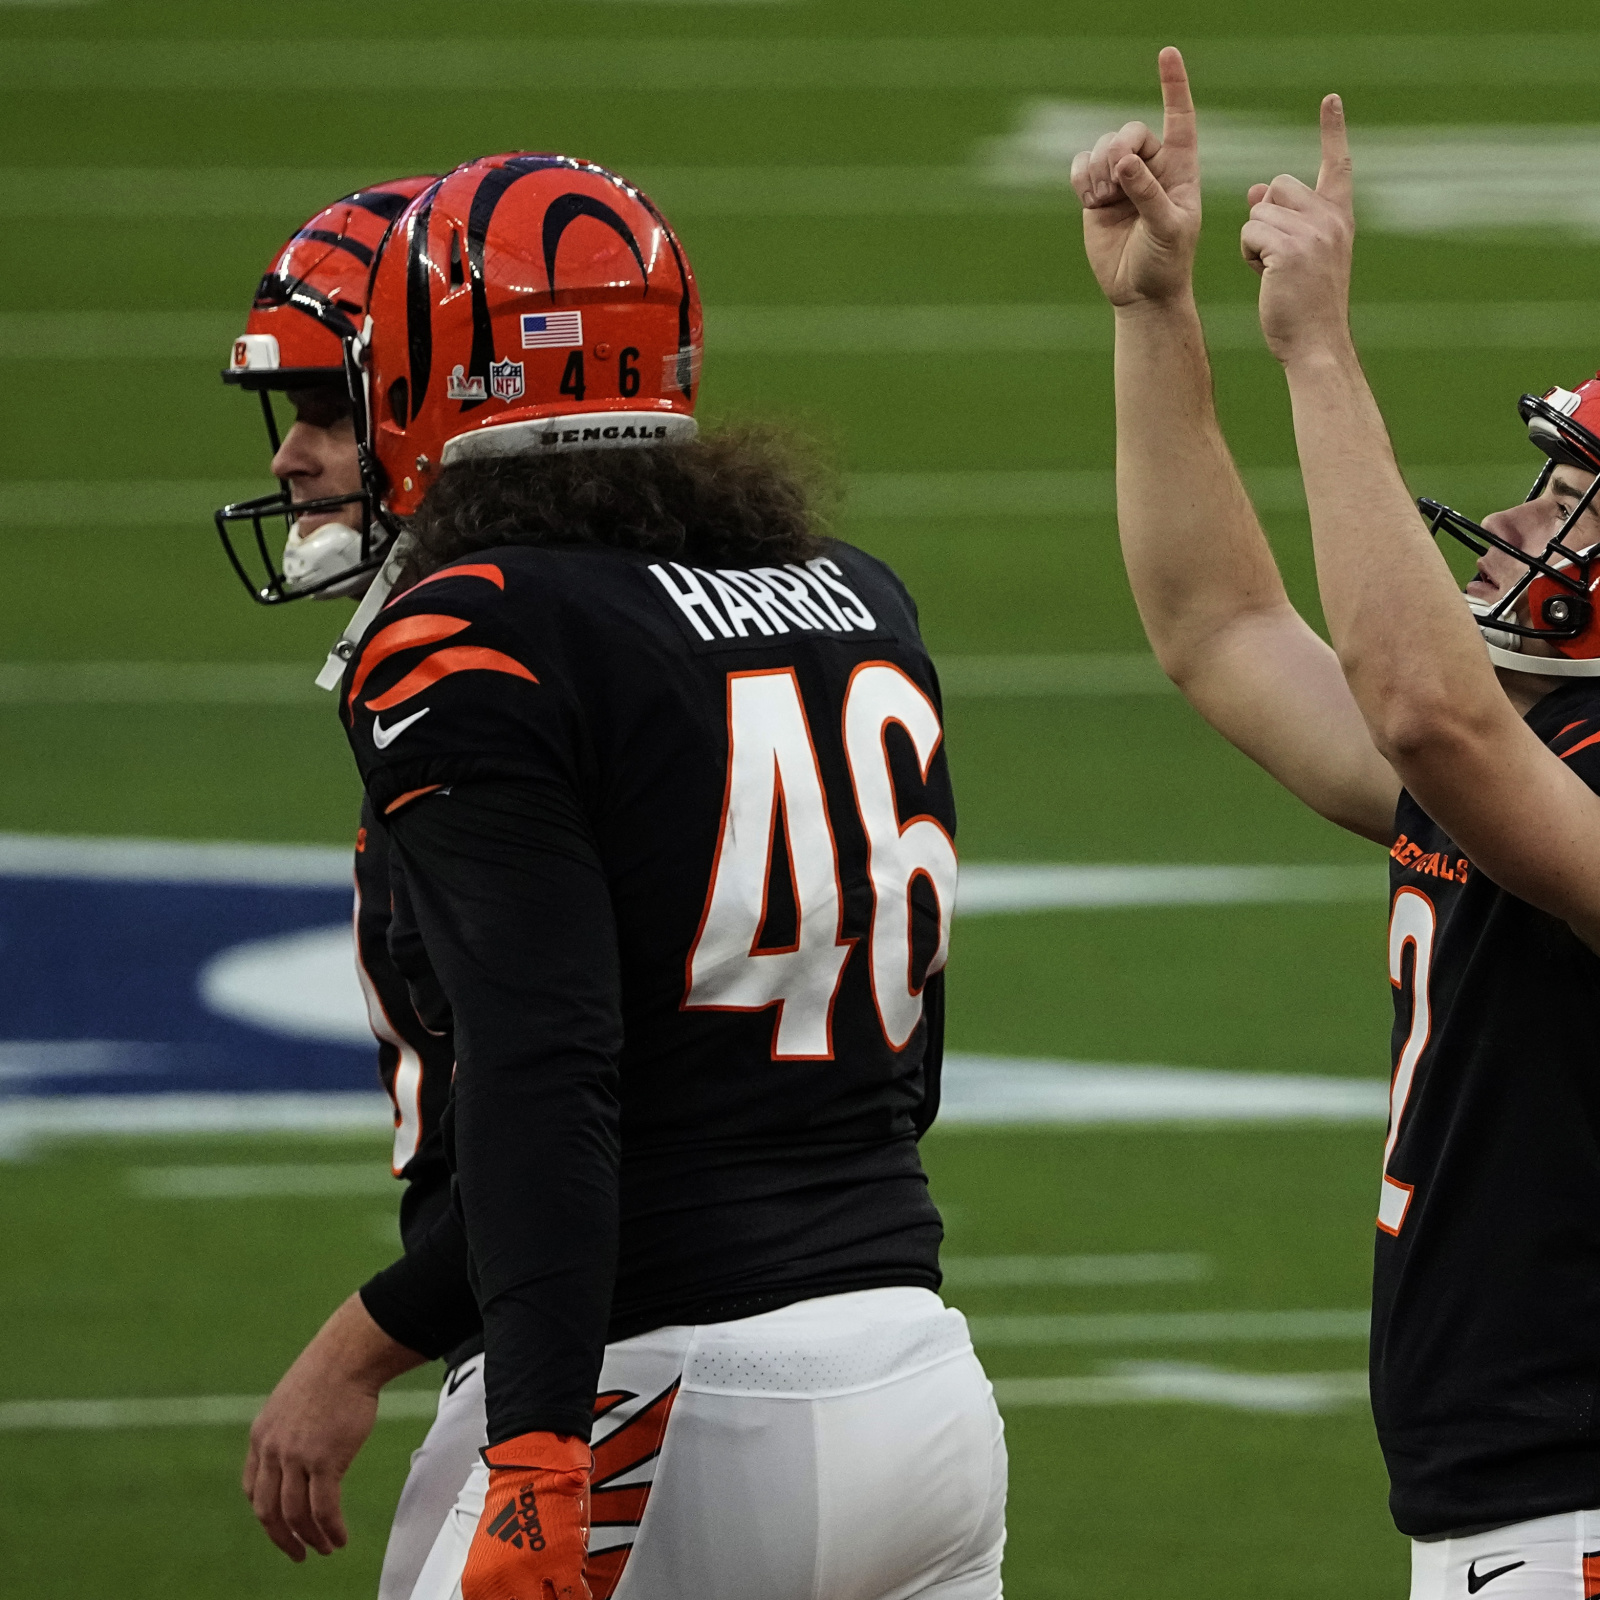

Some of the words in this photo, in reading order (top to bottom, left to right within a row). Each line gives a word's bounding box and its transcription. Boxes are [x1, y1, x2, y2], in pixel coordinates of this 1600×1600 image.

[496, 377, 520, 396] NFL
[541, 425, 667, 446] BENGALS
[647, 556, 877, 641] HARRIS
[679, 659, 958, 1061] 46
[1376, 885, 1436, 1237] 2
[517, 1482, 546, 1552] adidas
